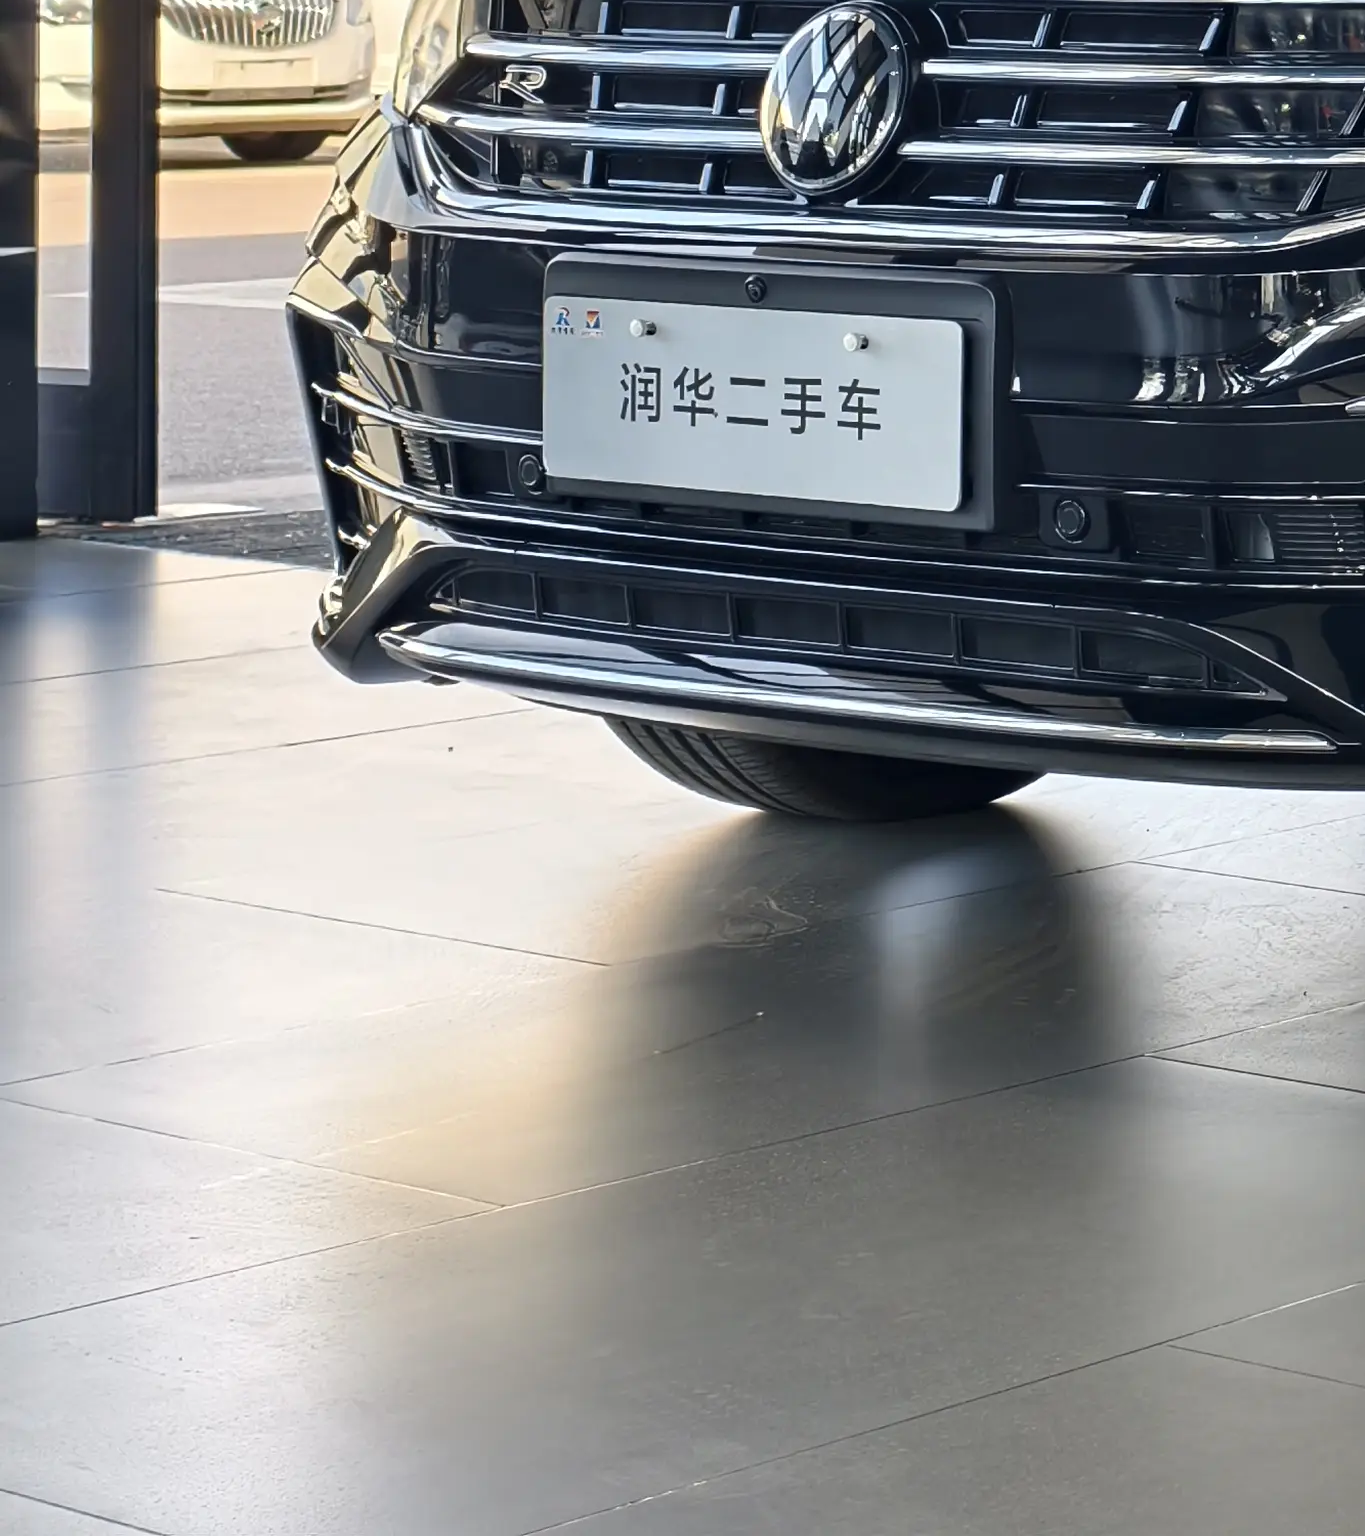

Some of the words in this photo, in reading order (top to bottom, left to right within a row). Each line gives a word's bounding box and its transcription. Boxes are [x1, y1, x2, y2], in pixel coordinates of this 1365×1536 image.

[500, 64, 547, 104] R
[619, 362, 882, 441] 润华二手车
